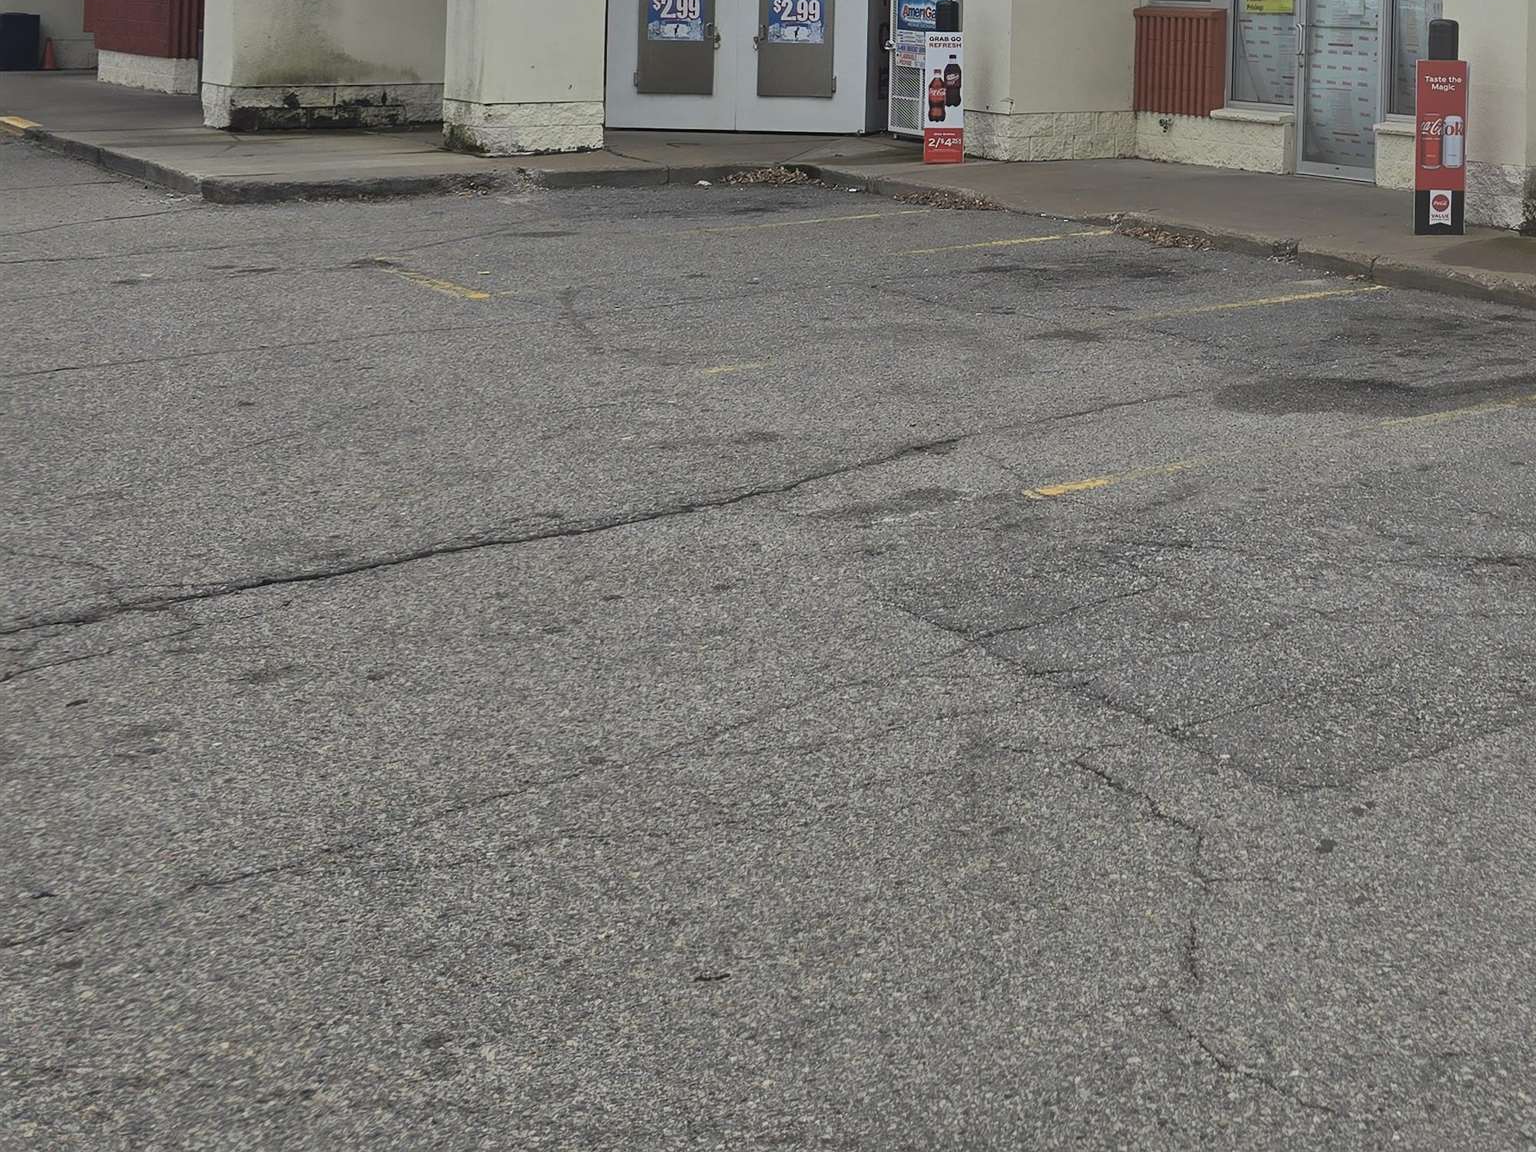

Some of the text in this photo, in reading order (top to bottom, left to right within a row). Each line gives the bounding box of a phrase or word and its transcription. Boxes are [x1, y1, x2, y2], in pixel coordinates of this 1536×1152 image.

[902, 5, 936, 19] AmeriGa
[1424, 75, 1463, 84] Taste the
[1431, 83, 1456, 92] Magic
